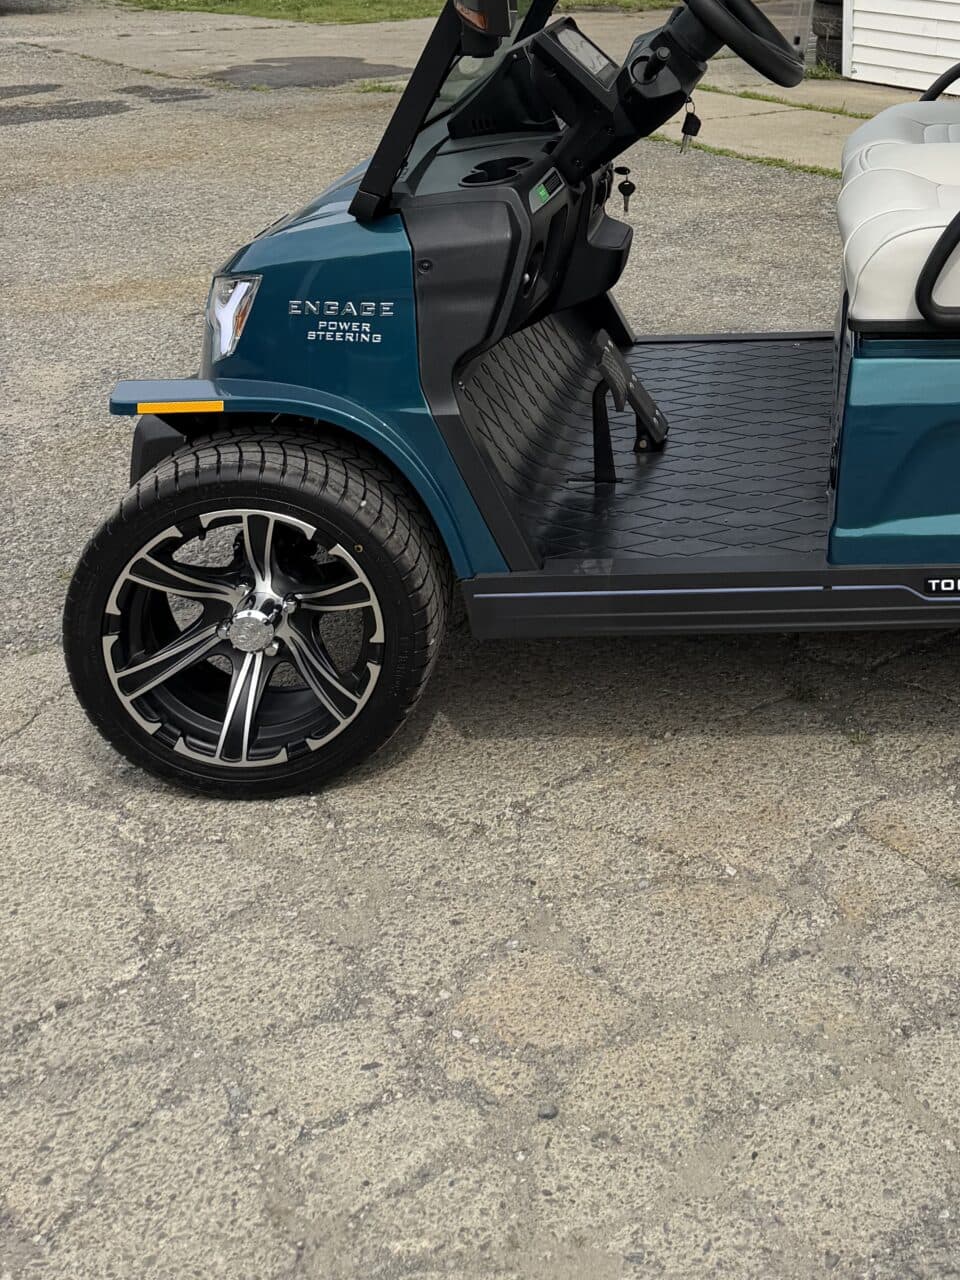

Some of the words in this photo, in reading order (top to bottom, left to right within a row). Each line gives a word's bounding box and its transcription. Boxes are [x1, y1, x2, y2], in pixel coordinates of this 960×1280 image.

[288, 300, 394, 317] ENGAGE
[318, 321, 371, 332] POWER
[307, 331, 382, 343] STEERING
